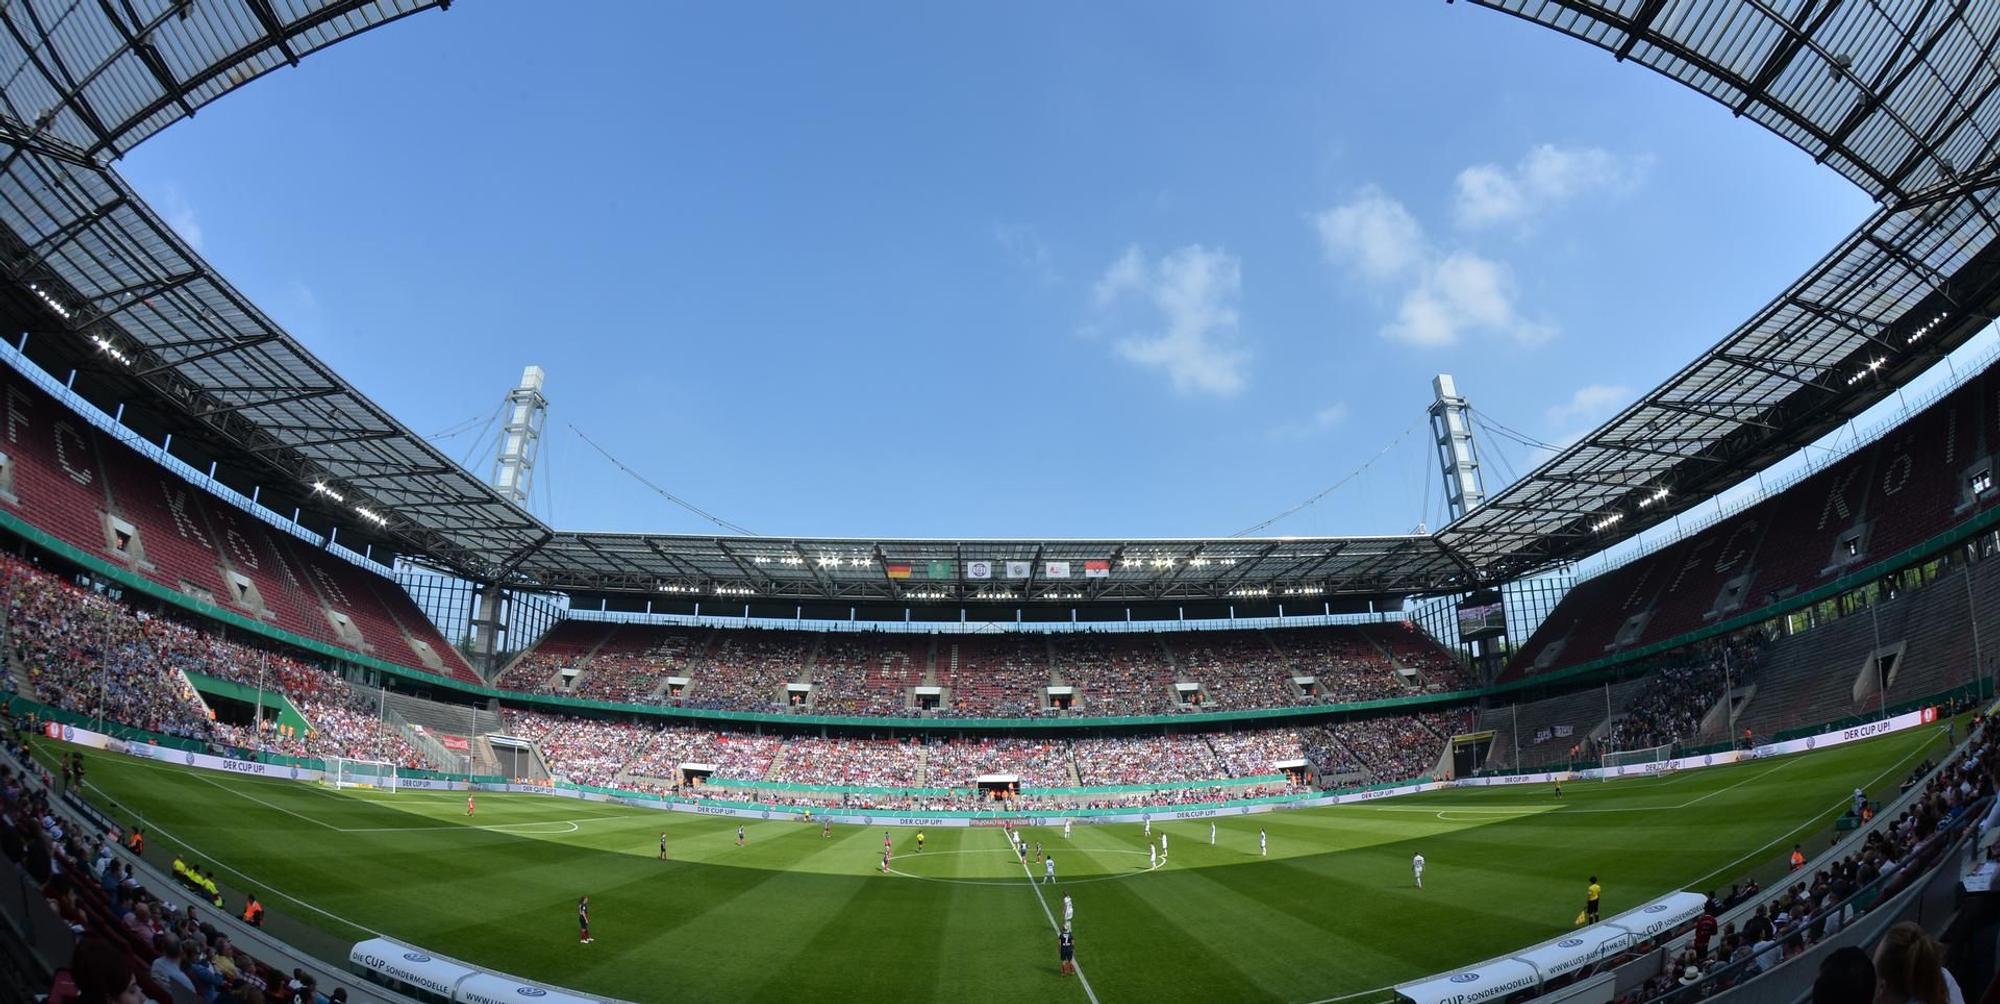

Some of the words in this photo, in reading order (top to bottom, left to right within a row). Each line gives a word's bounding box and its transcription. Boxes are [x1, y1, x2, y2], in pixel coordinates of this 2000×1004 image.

[1844, 729, 1859, 740] DER
[1860, 726, 1876, 736] CUP
[223, 760, 237, 769] DER
[238, 762, 252, 771] CUP
[1646, 920, 1664, 936] CUP
[352, 951, 363, 962] DIE
[364, 955, 386, 969] CUP
[385, 965, 449, 994] SONDERMODELLE.
[1467, 975, 1536, 1003] SONDERMODELLE.
